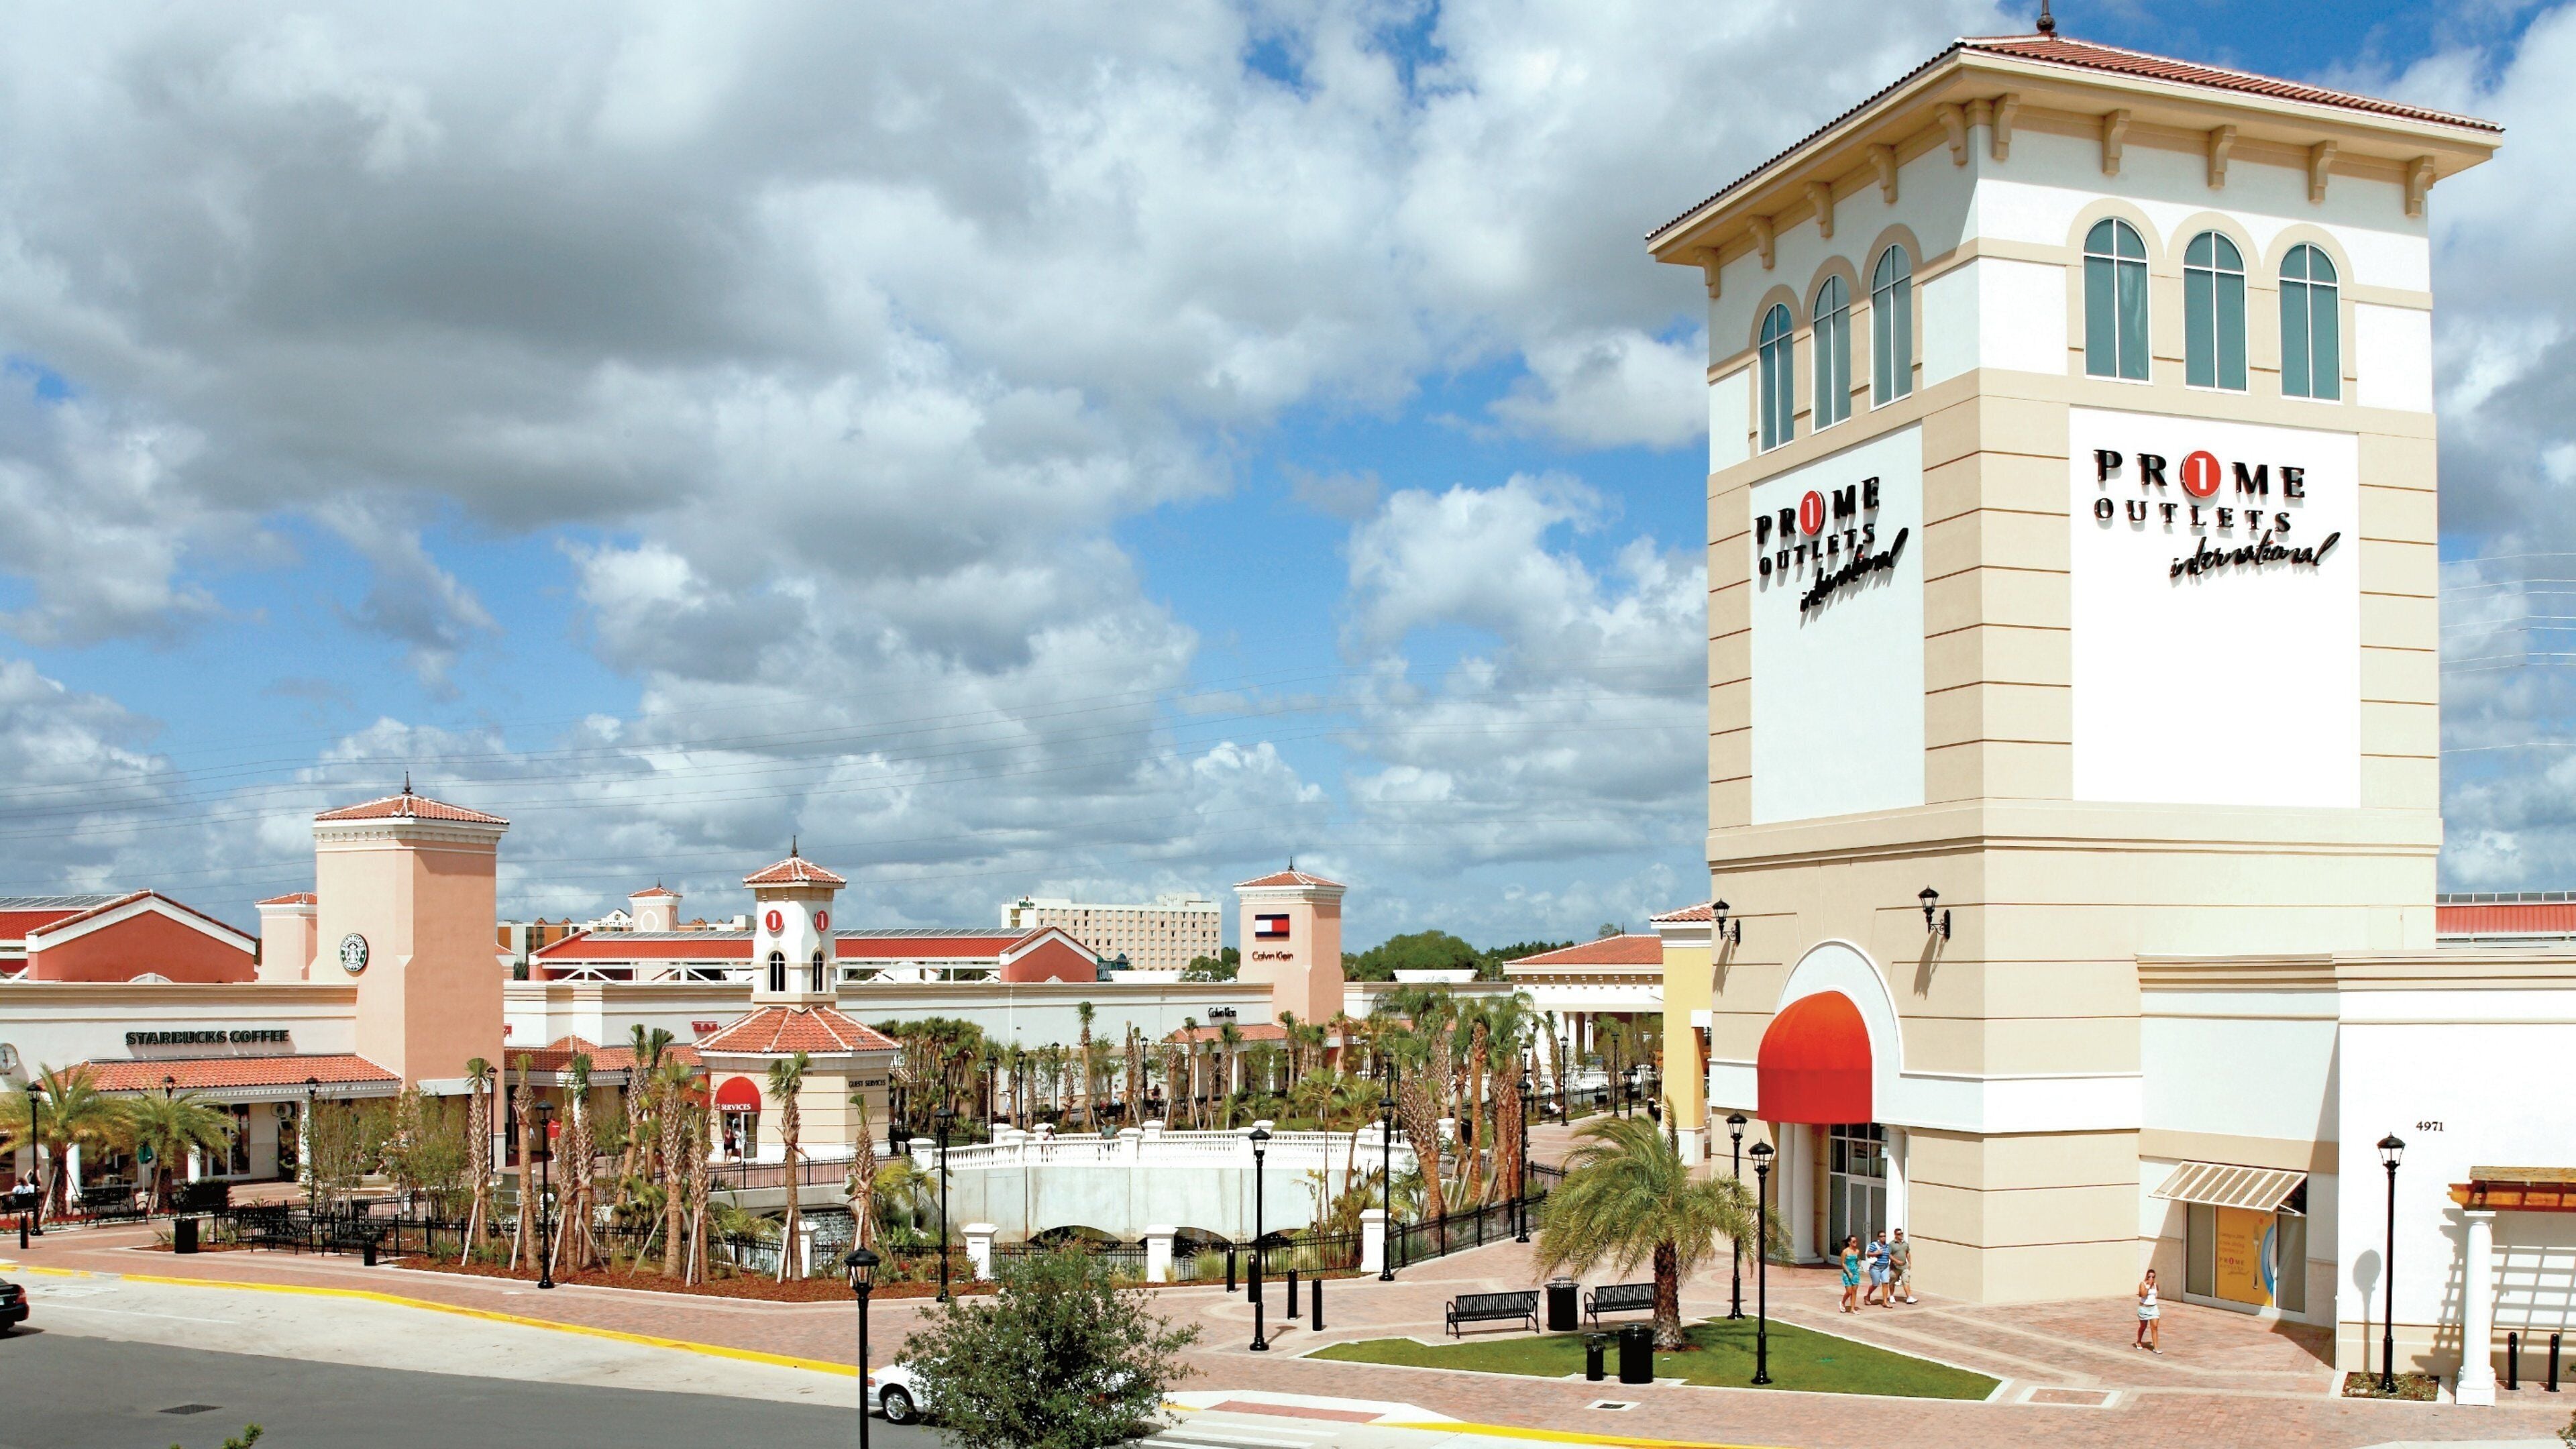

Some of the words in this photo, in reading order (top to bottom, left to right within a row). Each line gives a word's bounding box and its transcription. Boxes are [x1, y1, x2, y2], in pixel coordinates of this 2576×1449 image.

[2094, 497, 2291, 533] OUTLETS
[1759, 523, 1876, 576] OUTLETS
[2169, 529, 2341, 578] international
[1252, 951, 1275, 962] Calvin
[1275, 951, 1293, 961] Klein
[125, 1030, 227, 1045] STARBUCKS
[229, 1029, 290, 1043] COFFEE
[865, 1079, 885, 1087] SERVICES
[2416, 1120, 2445, 1132] 4971
